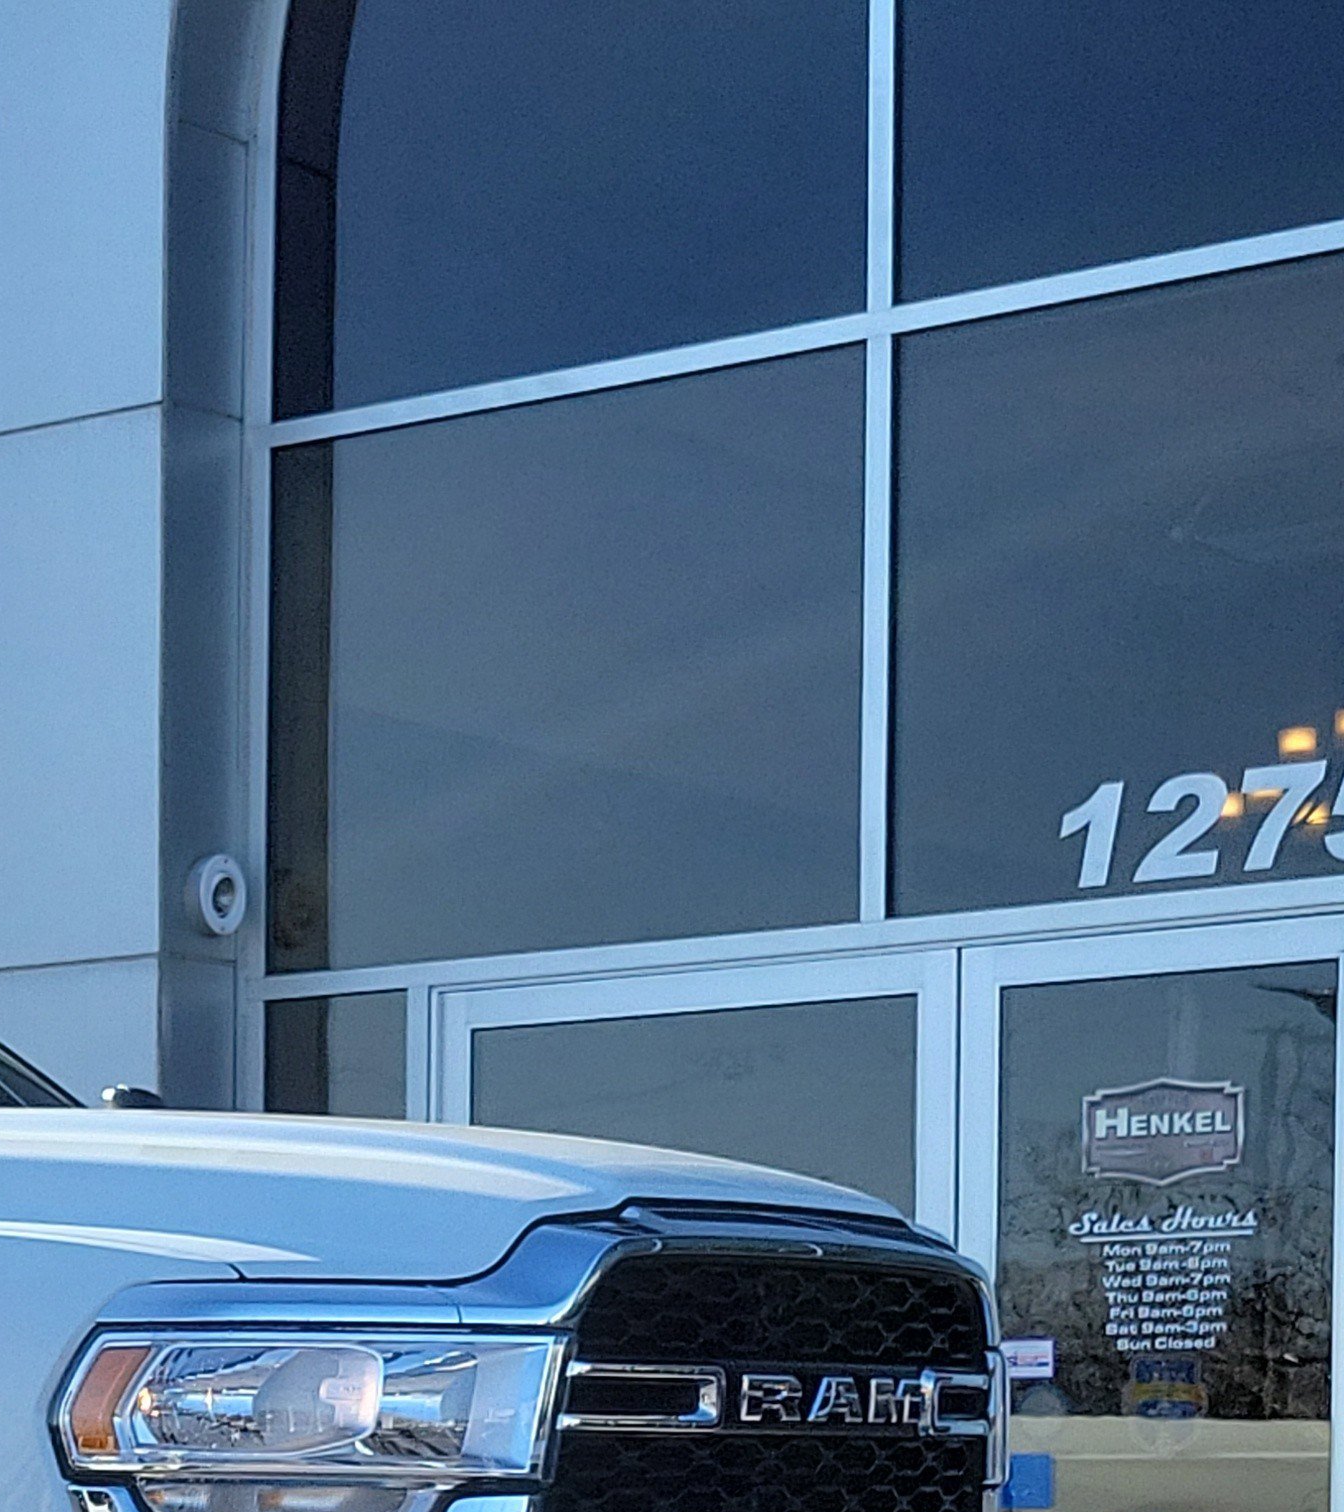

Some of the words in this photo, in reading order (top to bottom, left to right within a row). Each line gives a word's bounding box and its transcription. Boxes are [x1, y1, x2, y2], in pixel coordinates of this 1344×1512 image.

[1058, 759, 1344, 889] 127
[1095, 1107, 1232, 1139] HENKEL
[1069, 1211, 1152, 1236] Sales
[1161, 1205, 1258, 1232] Hours
[1102, 1243, 1141, 1257] Mon
[1145, 1240, 1231, 1256] 9am-7pm
[1104, 1260, 1136, 1272] Tue
[1102, 1275, 1142, 1288] Wed
[1145, 1272, 1231, 1287] 9am-7pm
[1105, 1291, 1138, 1304] Thu
[1109, 1307, 1134, 1320] Fri
[1105, 1322, 1138, 1335] Sat
[1116, 1338, 1151, 1351] Sun
[1154, 1336, 1216, 1350] Closed
[739, 1373, 923, 1424] RAM
